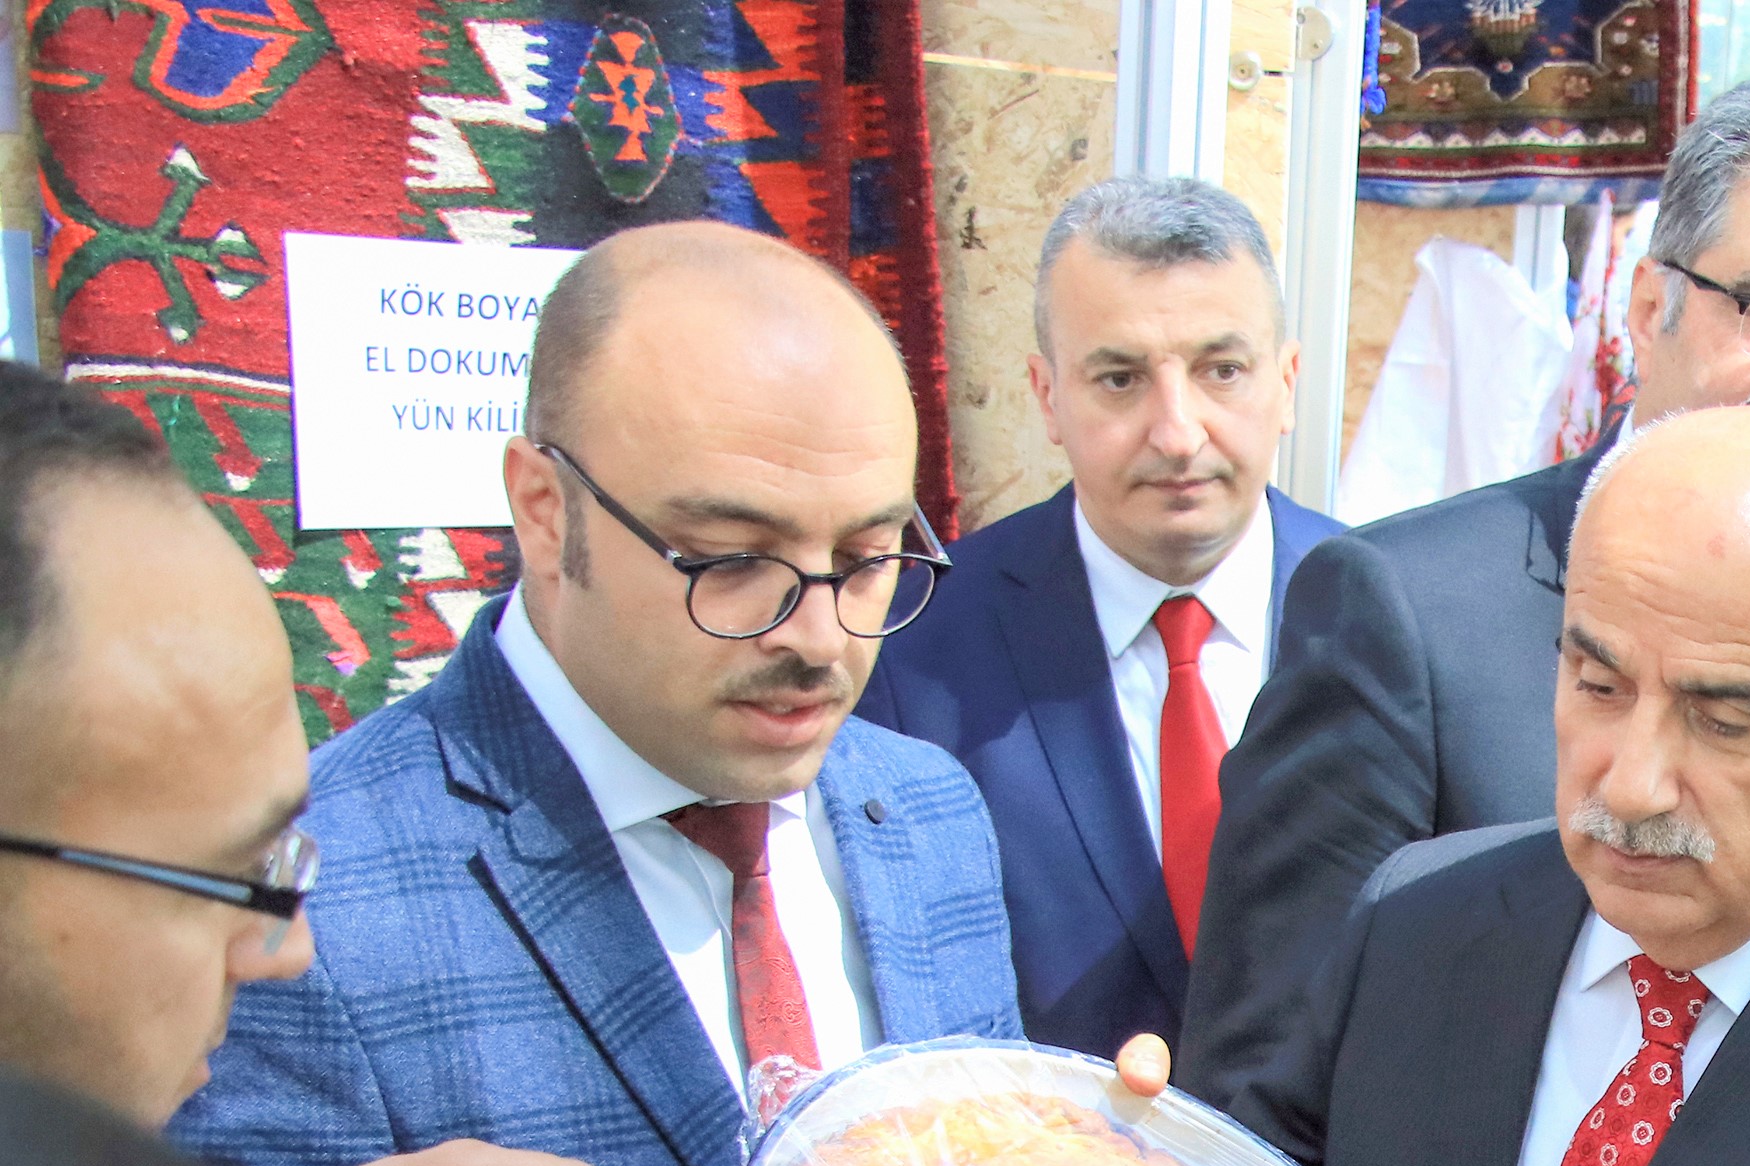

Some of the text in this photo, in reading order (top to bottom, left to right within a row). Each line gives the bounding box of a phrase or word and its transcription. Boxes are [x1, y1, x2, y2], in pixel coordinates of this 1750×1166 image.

[380, 283, 539, 321] KÖK BOYA
[365, 346, 529, 377] EL DOKUM
[392, 398, 518, 432] YÜN KİLİ
